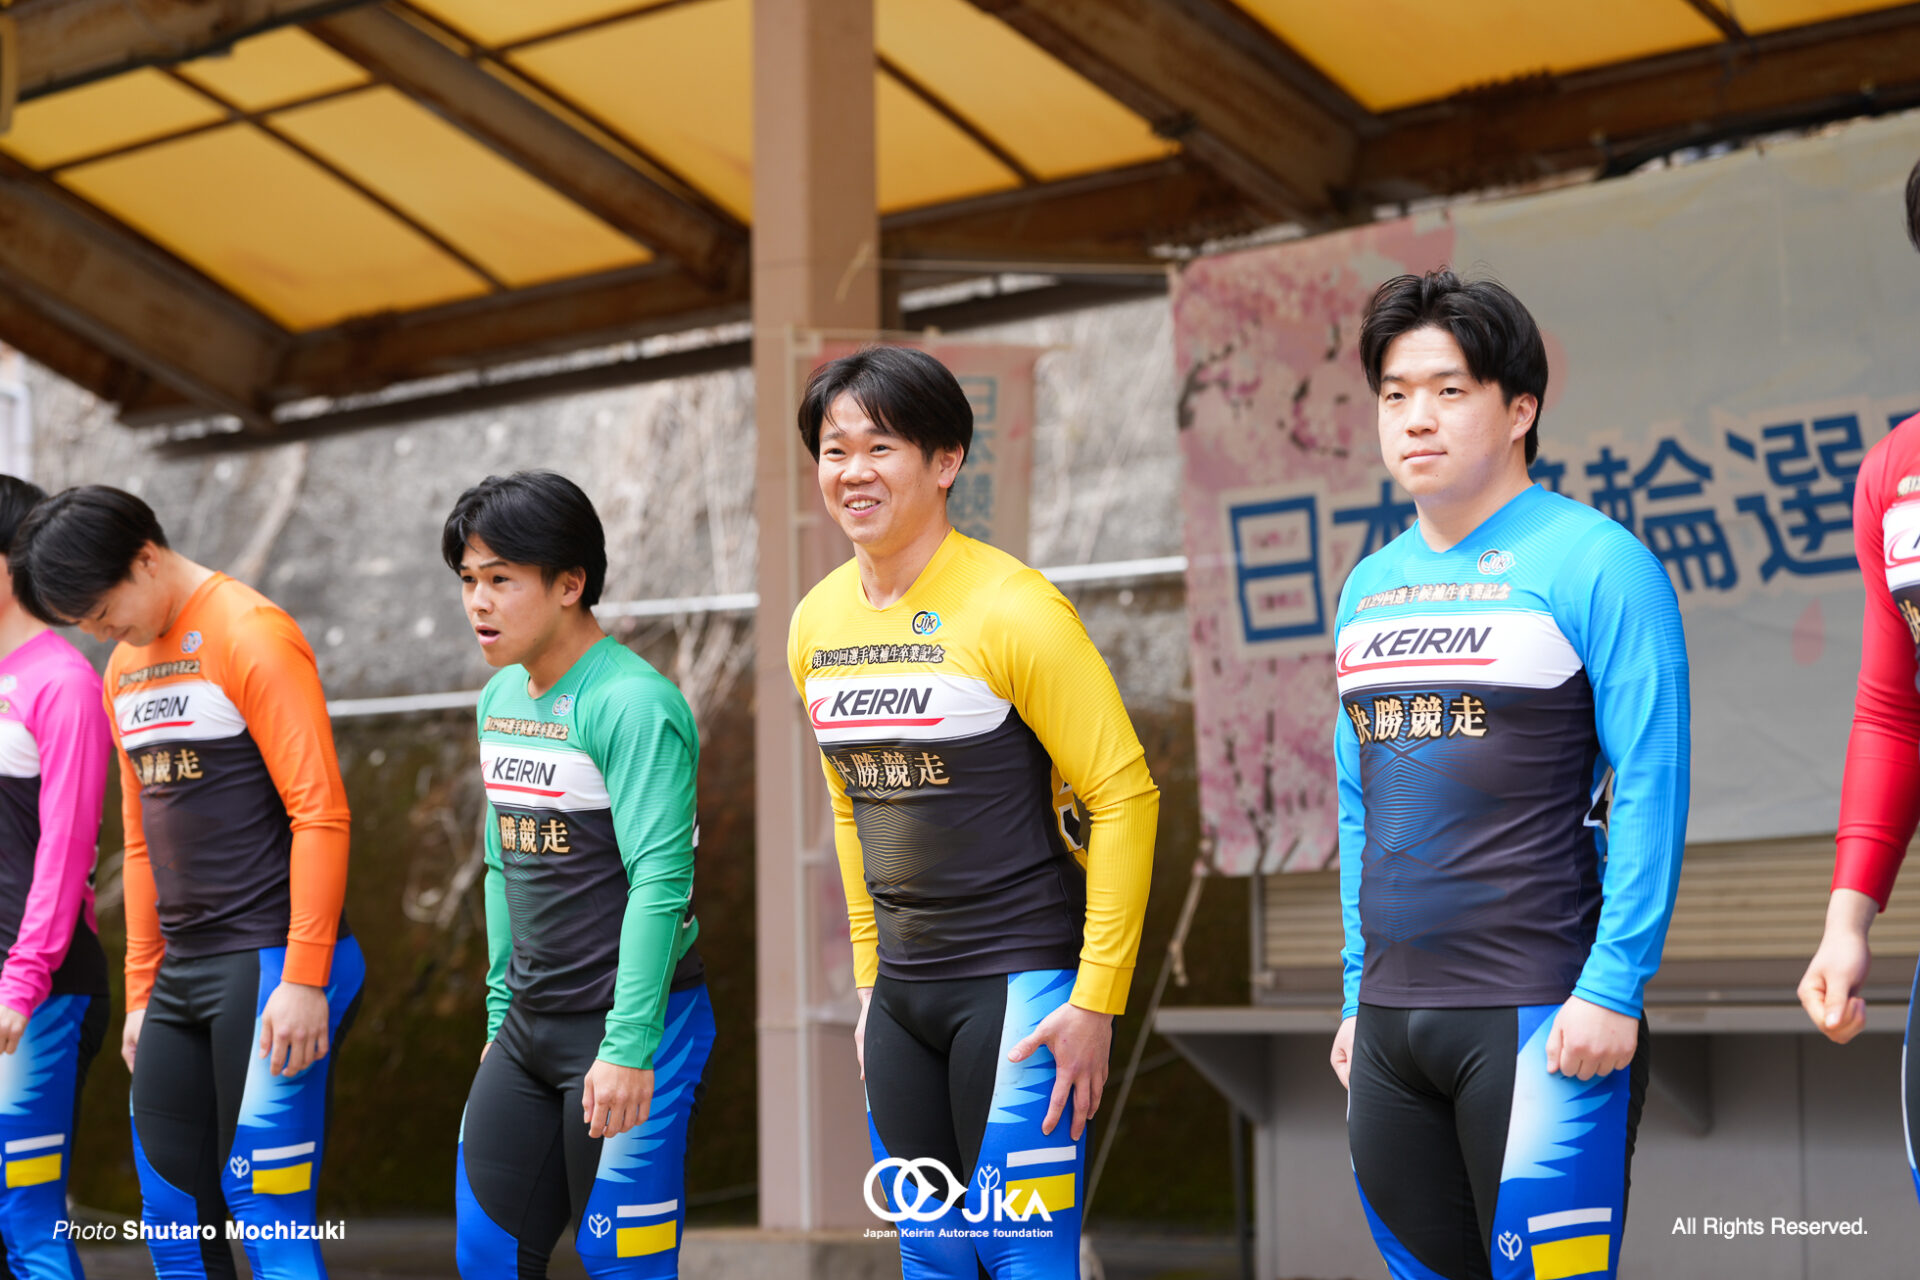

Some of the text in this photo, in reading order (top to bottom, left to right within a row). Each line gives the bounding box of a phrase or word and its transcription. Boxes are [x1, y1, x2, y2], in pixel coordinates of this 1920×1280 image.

[812, 644, 946, 669] 第129回選手候補生卒業記念
[1361, 626, 1492, 660] KEIRIN
[131, 695, 189, 726] KEIRIN
[830, 687, 932, 717] KEIRIN
[1348, 694, 1488, 745] 決勝競走
[491, 756, 557, 786] KEIRIN
[498, 814, 571, 854] 勝競走
